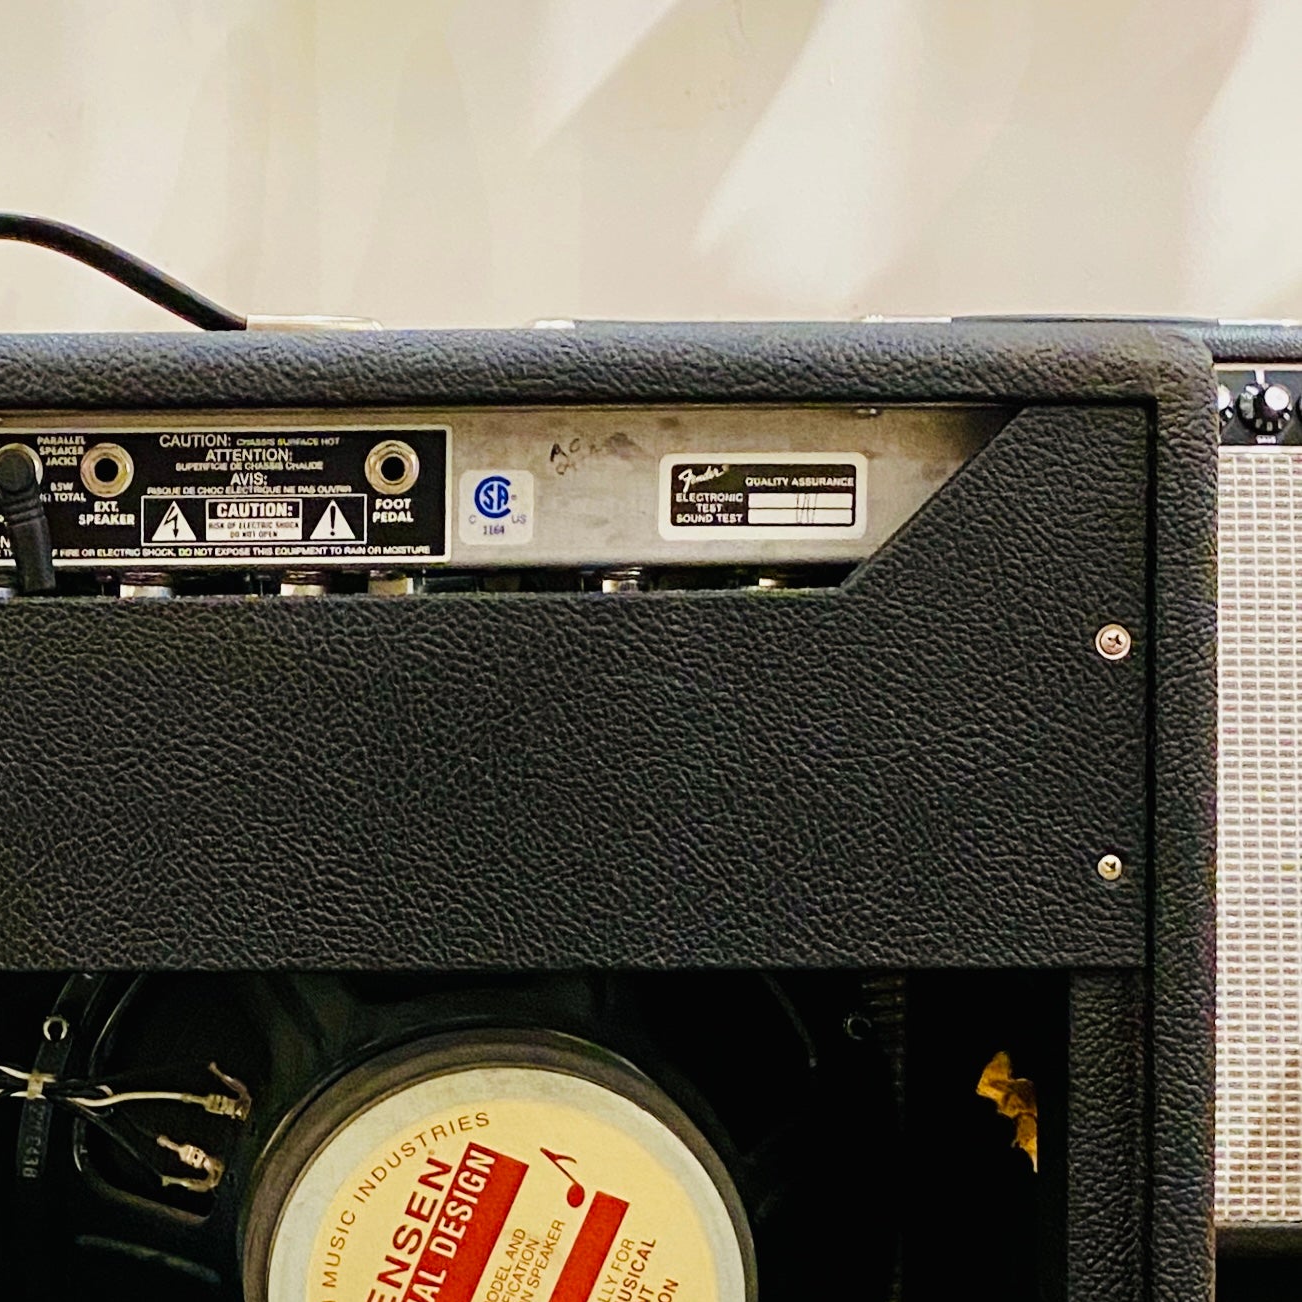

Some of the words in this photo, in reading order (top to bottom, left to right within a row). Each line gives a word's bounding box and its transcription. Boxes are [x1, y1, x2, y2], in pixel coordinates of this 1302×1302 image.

[37, 436, 86, 445] PARALLEL
[159, 434, 231, 448] CAUTION:
[39, 446, 84, 455] SPEAKER
[205, 448, 292, 462] ATTENTION:
[46, 457, 78, 466] JACKS
[230, 472, 268, 486] AVIS:
[678, 465, 725, 493] Fender
[745, 477, 789, 487] QUALITY
[791, 476, 855, 487] ASSURANCE
[197, 486, 224, 495] CHOC
[54, 492, 86, 503] TOTAL
[676, 493, 744, 503] ELECTRONIC
[94, 501, 119, 512] EXT.
[216, 502, 293, 518] CAUTION:
[375, 498, 412, 510] FOOT
[696, 503, 723, 513] TEST
[79, 514, 135, 526] SPEAKER
[372, 511, 414, 523] PEDAL
[511, 515, 527, 524] US
[676, 513, 713, 523] SOUND
[716, 513, 743, 523] TEST
[483, 525, 505, 535] 1164
[60, 549, 80, 557] FIRE
[82, 549, 95, 557] OR
[97, 548, 141, 557] ELECTRIC
[178, 548, 193, 556] DO
[194, 547, 213, 556] NOT
[215, 547, 250, 556] EXPOSE
[253, 547, 273, 556] THIS
[275, 546, 328, 556] EQUIPMENT
[330, 546, 342, 555] TO
[344, 546, 366, 555] RAIN
[368, 546, 382, 555] OR
[383, 545, 430, 555] MOISTURE
[322, 1210, 355, 1288] MUSIC
[353, 1112, 490, 1204] INDUSTRIES
[429, 1150, 496, 1259] DESIGN
[505, 1228, 526, 1261] AND
[527, 1219, 566, 1289] SPEAKER
[611, 1238, 635, 1272] FOR
